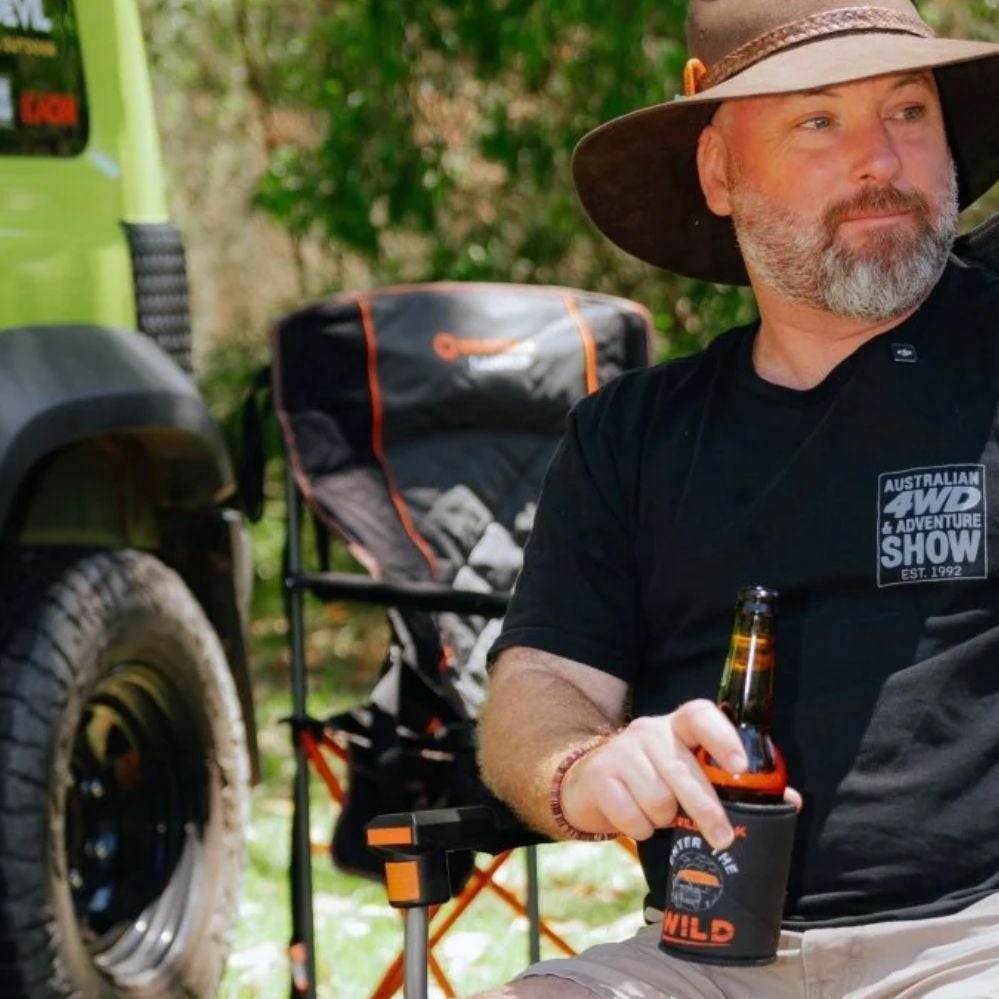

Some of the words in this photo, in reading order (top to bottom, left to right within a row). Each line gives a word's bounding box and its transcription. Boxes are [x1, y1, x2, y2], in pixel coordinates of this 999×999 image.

[884, 471, 979, 493] AUSTRALIAN
[883, 486, 981, 518] 4WD
[881, 521, 892, 535] &
[896, 513, 982, 534] ADVENTURE
[881, 529, 981, 569] SHOW
[901, 567, 927, 580] EST.
[931, 566, 962, 578] 1992
[663, 911, 735, 943] WILD
